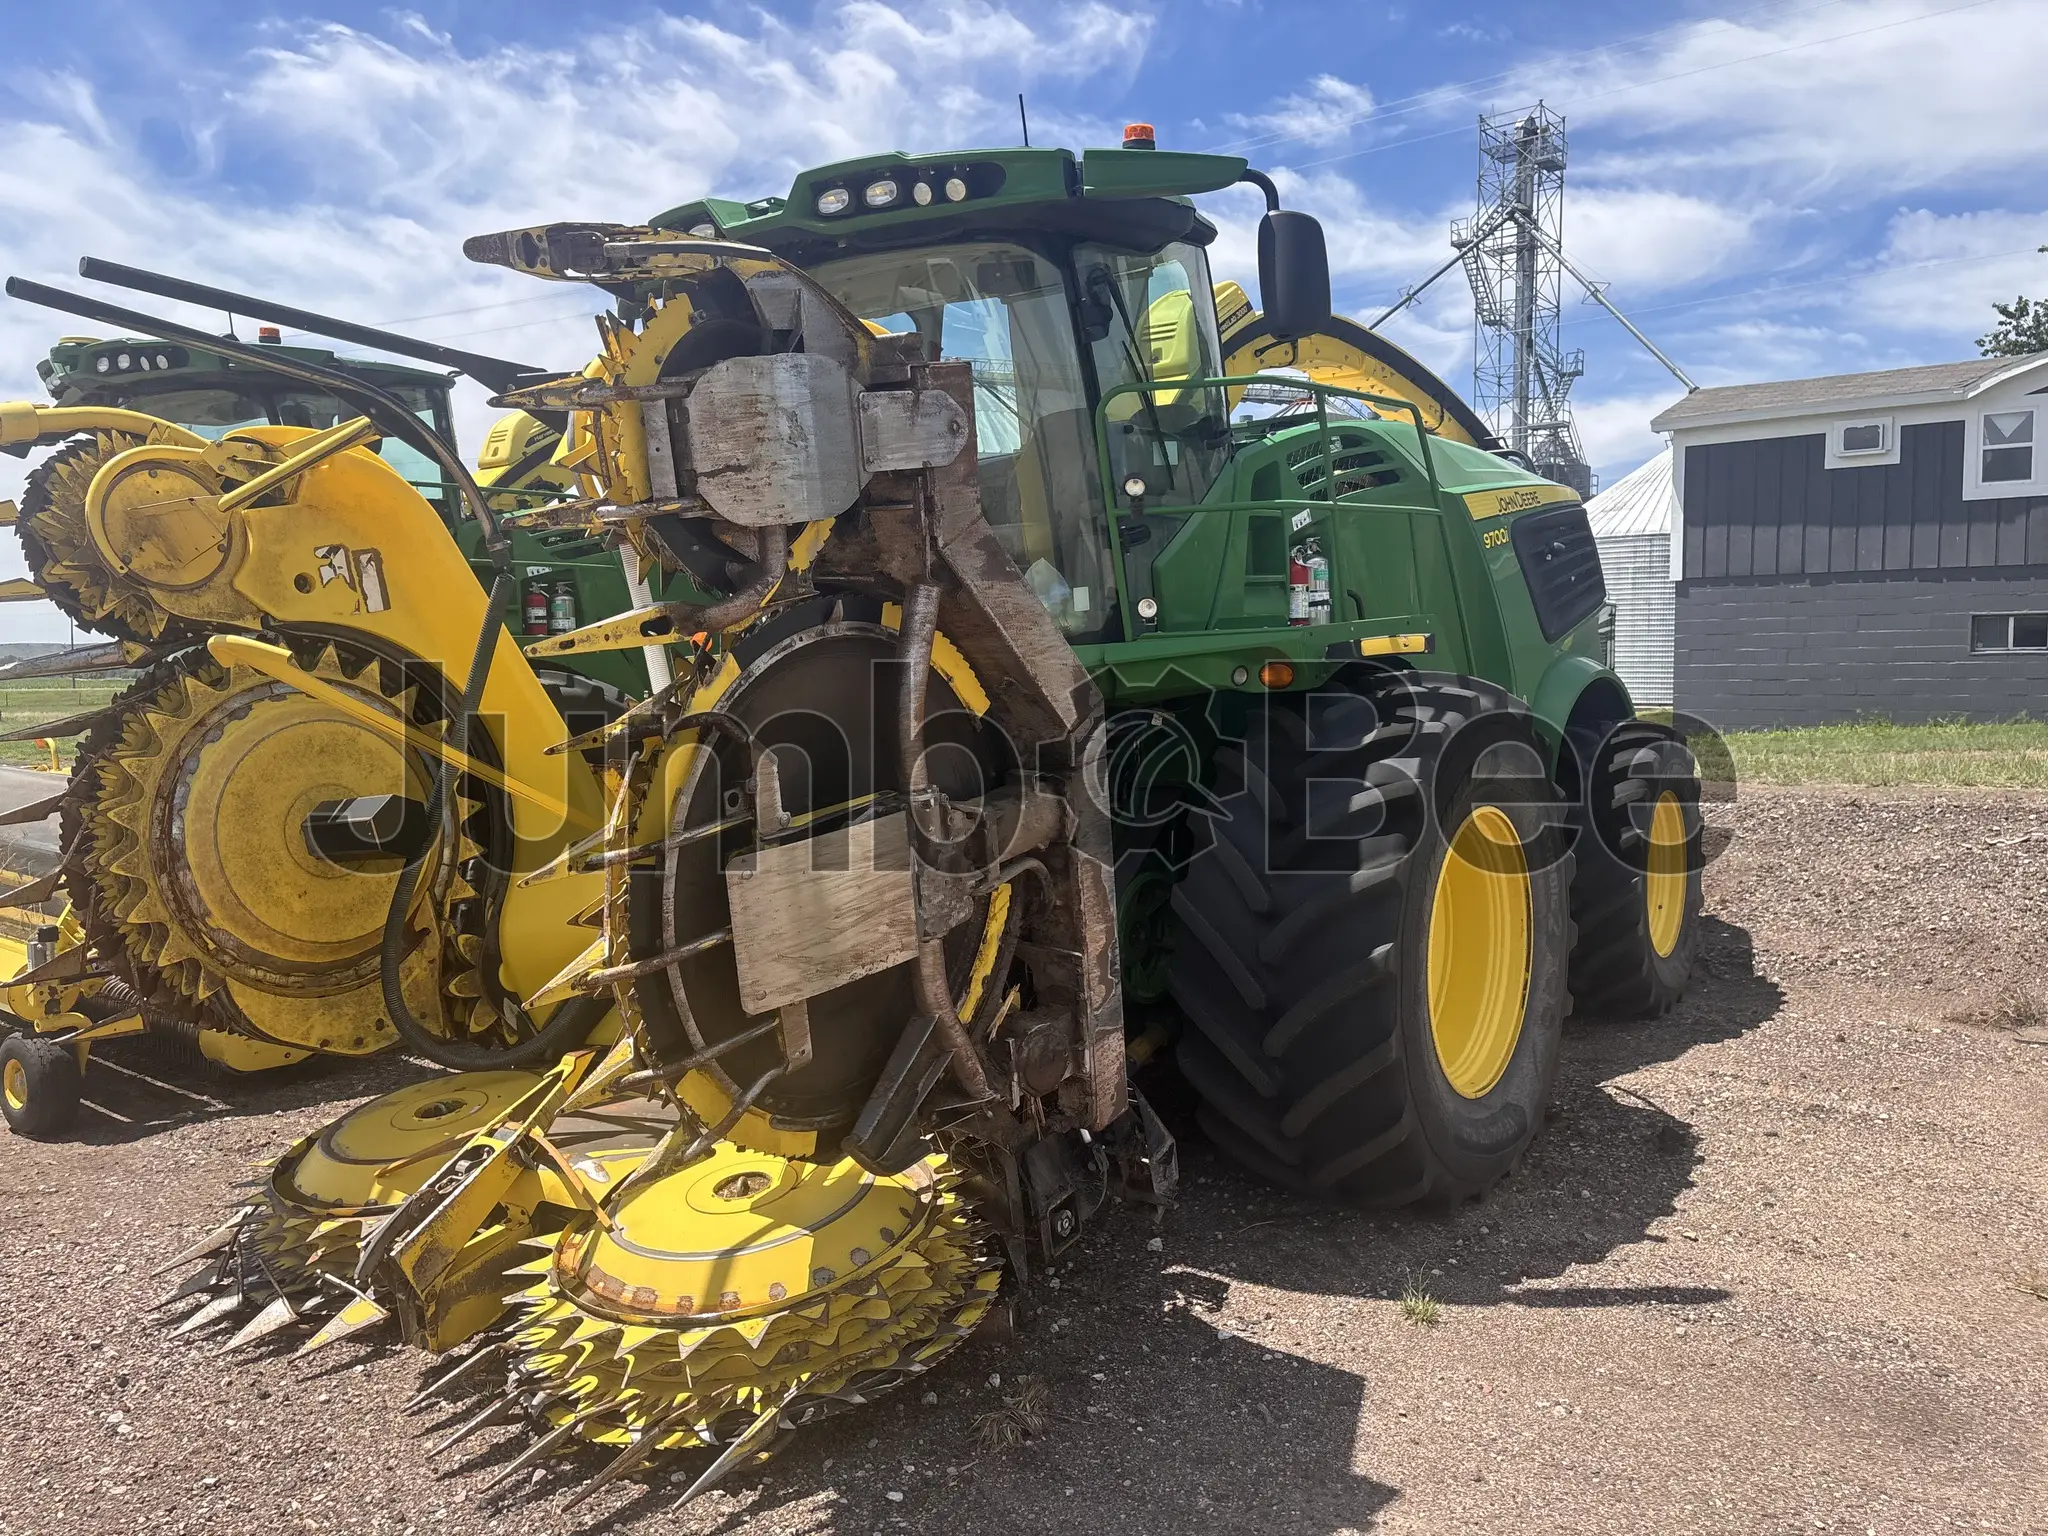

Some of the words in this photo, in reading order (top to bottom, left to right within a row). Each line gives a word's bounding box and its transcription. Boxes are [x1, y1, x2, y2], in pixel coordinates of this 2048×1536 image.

[1495, 495, 1518, 512] JOHN
[1514, 491, 1541, 508] DEERE
[1483, 526, 1510, 549] 9700i
